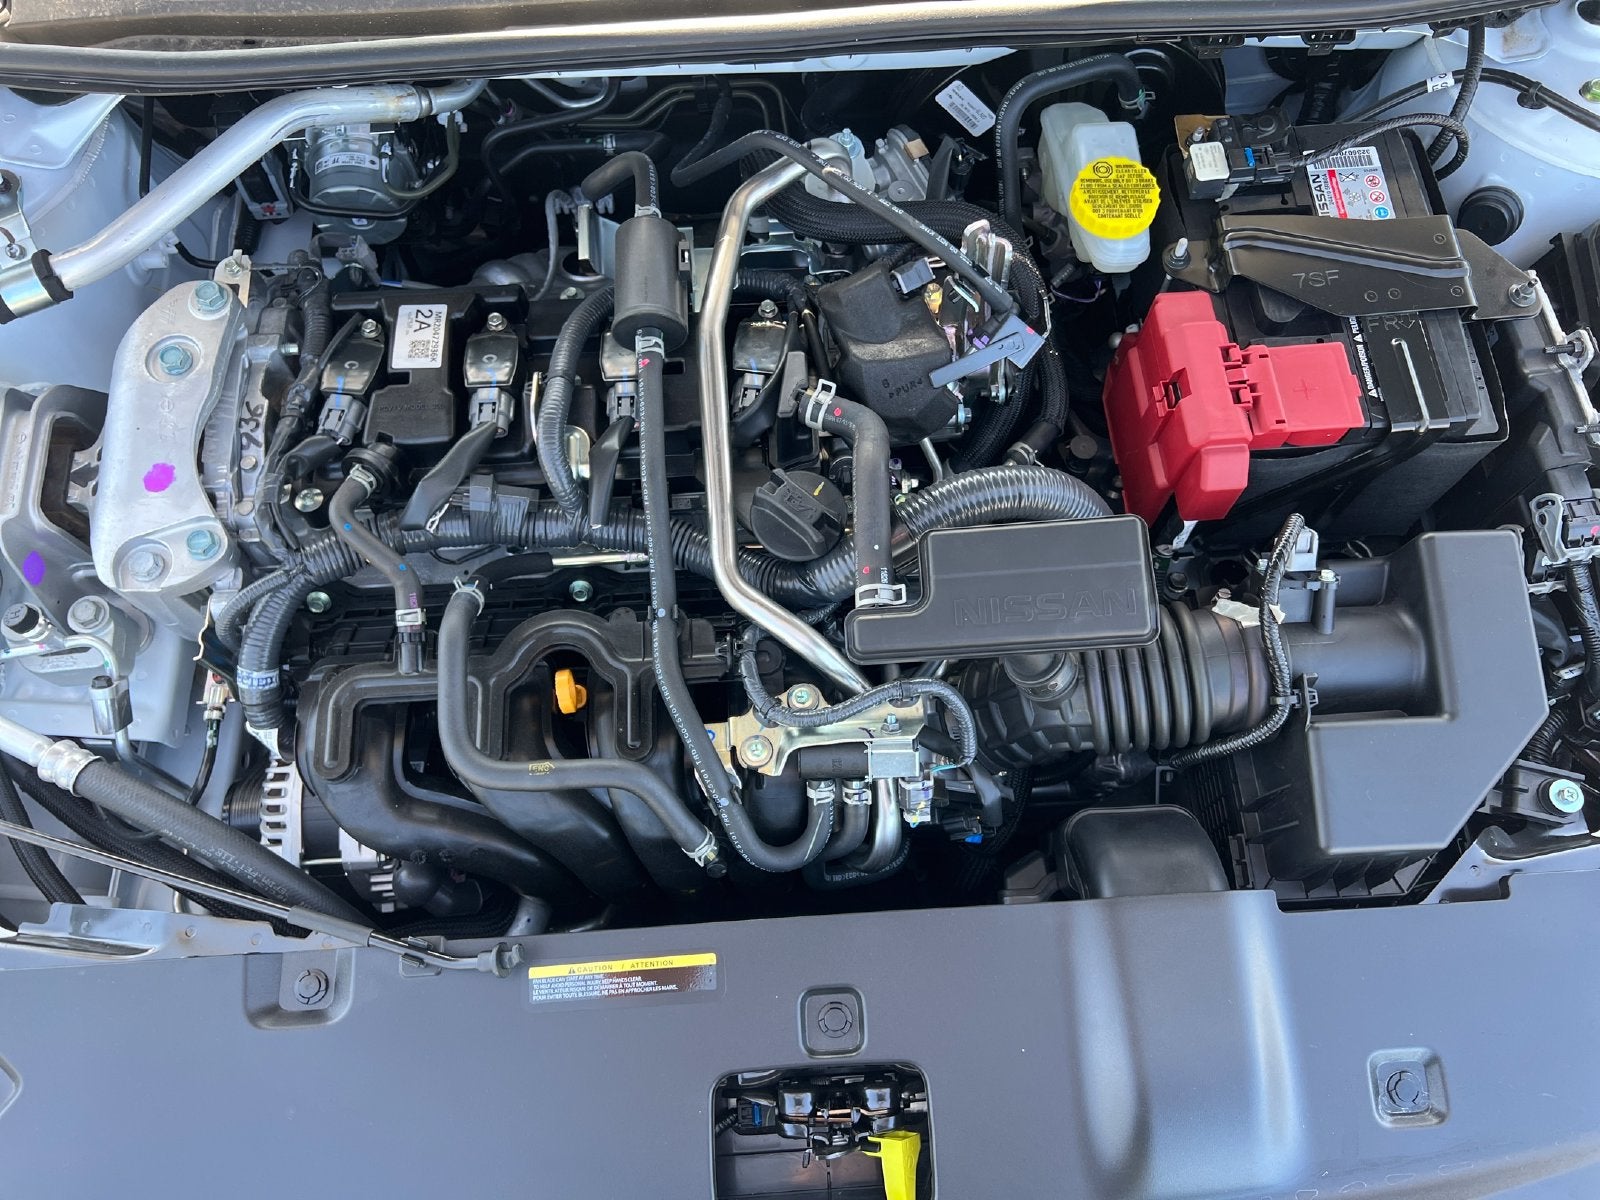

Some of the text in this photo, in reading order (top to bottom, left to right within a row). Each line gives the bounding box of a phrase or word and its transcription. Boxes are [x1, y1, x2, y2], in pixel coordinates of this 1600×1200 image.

[1311, 174, 1330, 215] ISSAN
[1292, 270, 1339, 288] 7SF
[414, 309, 433, 333] 2A
[954, 587, 1136, 625] NISSAN
[577, 965, 612, 973] CAUTION
[630, 960, 674, 968] ATTENTION
